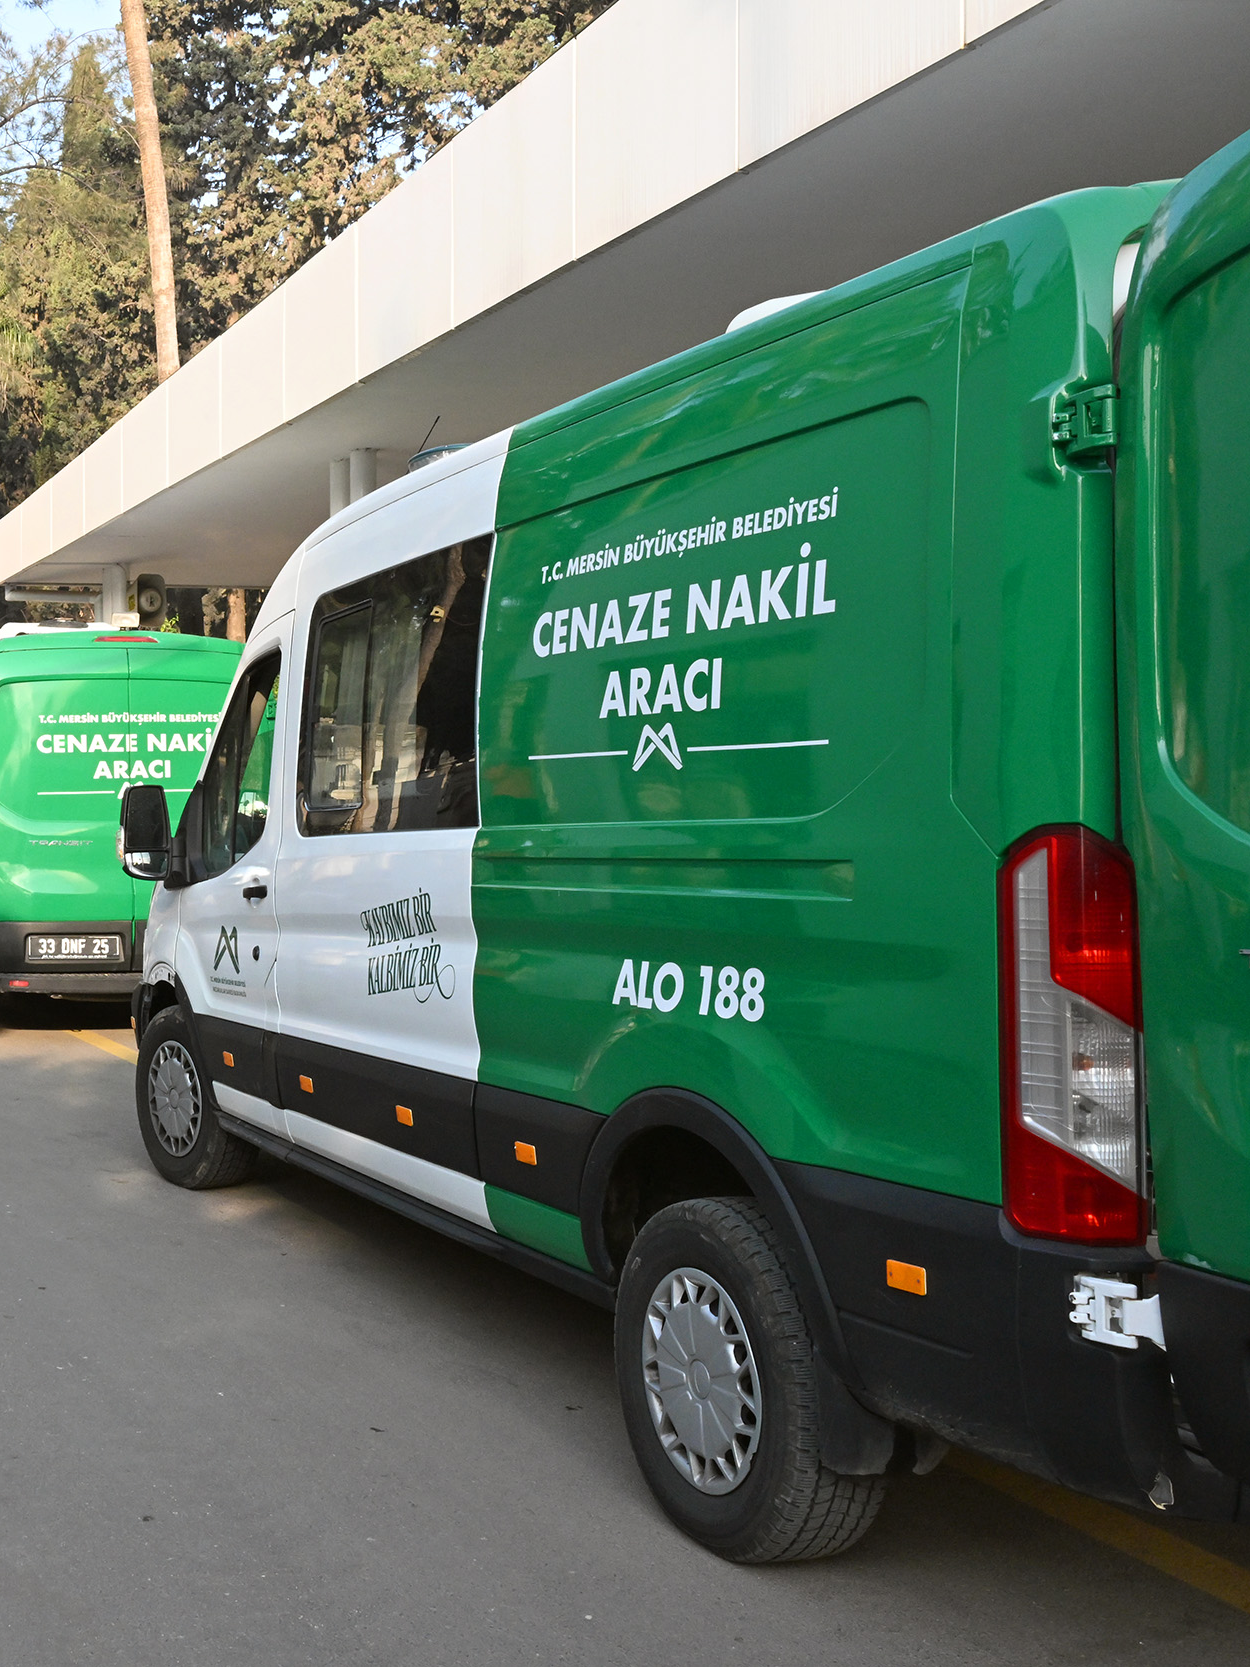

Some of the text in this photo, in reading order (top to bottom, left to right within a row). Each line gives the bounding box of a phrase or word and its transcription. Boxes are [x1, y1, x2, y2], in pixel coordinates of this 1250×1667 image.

[541, 486, 839, 585] T.C. MERSİN BÜYÜKŞEHİR BELEDİYESİ
[532, 542, 836, 658] CENAZE NAKİL
[599, 657, 723, 719] ARACI
[36, 727, 213, 754] CENAZE NAKİ
[38, 714, 57, 724] T.C.
[58, 712, 99, 724] MERSİN
[101, 711, 167, 726] BÜYÜKŞEHİR
[93, 759, 172, 780] ARACI
[38, 938, 56, 954] 33
[92, 938, 110, 954] 25
[360, 887, 437, 948] KAYBIMIZ BİR
[367, 942, 420, 996] KALBİMİZ
[611, 958, 766, 1023] ALO 188
